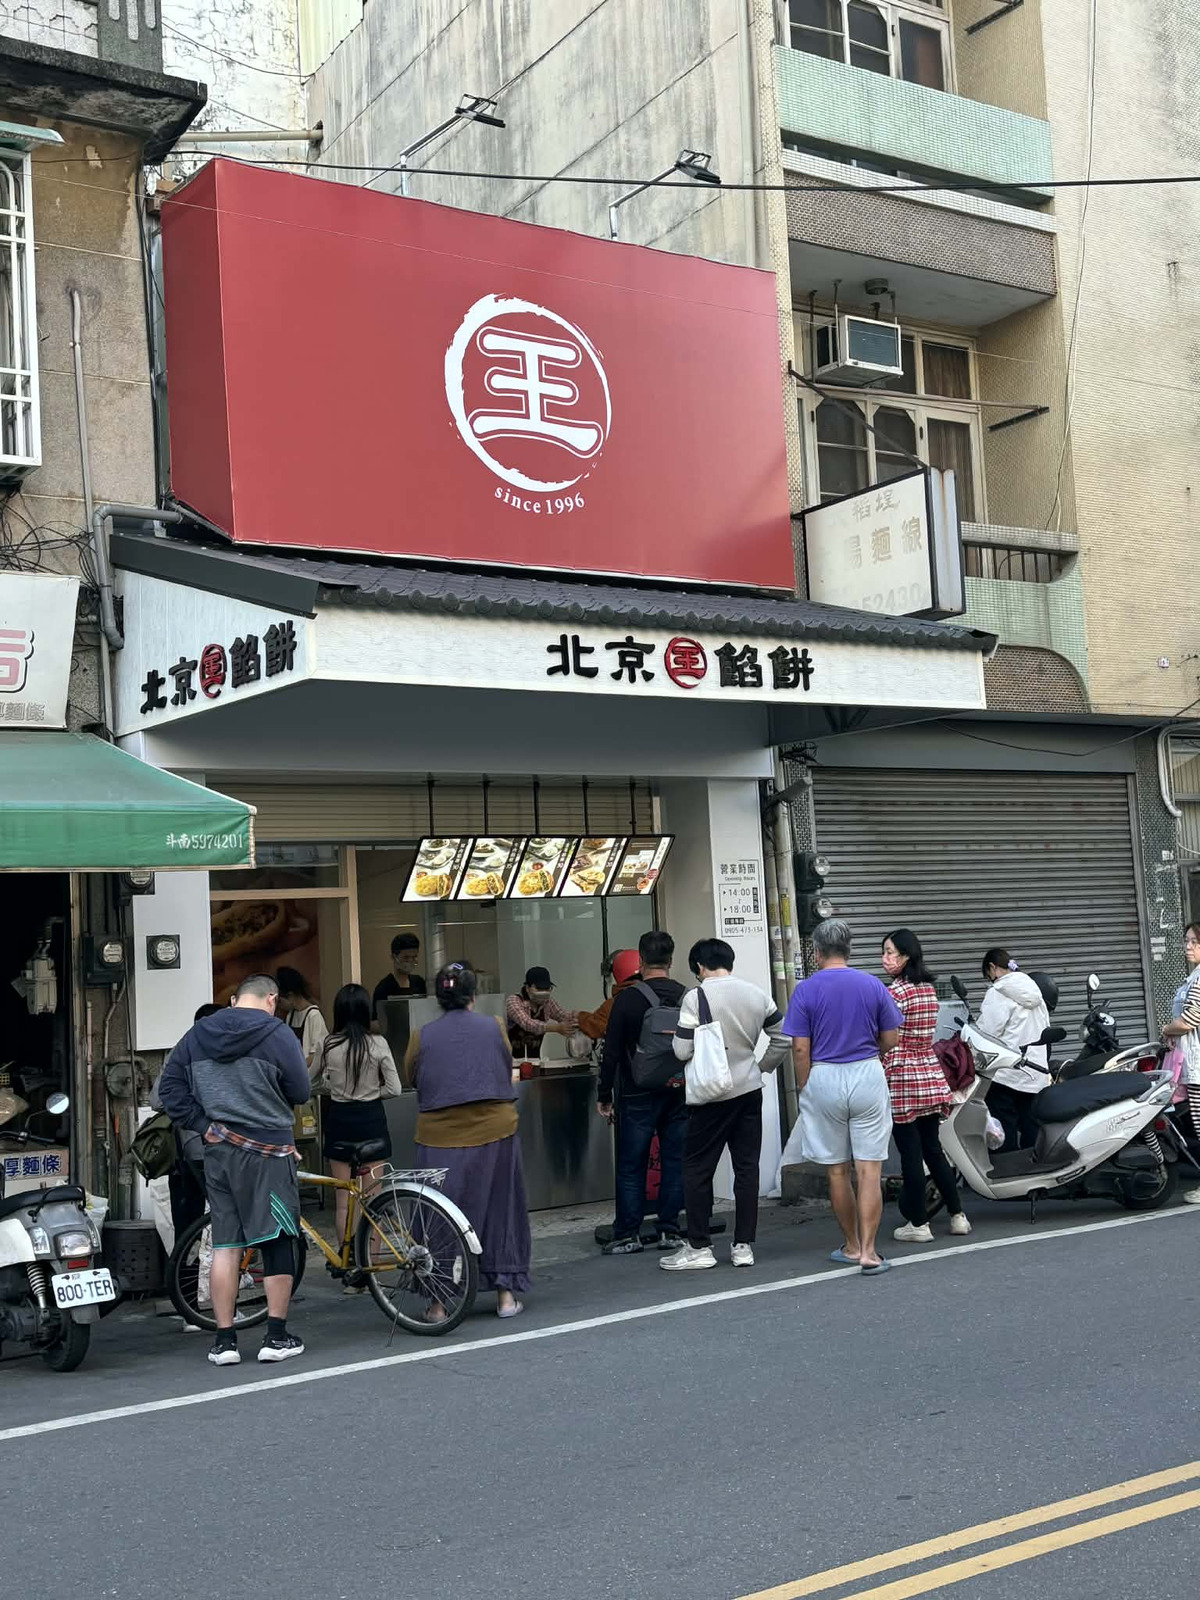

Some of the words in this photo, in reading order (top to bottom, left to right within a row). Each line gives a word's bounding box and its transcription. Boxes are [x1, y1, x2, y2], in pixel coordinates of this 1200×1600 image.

[494, 486, 541, 514] since
[545, 492, 585, 514] 1996
[0, 702, 45, 722] 麵條
